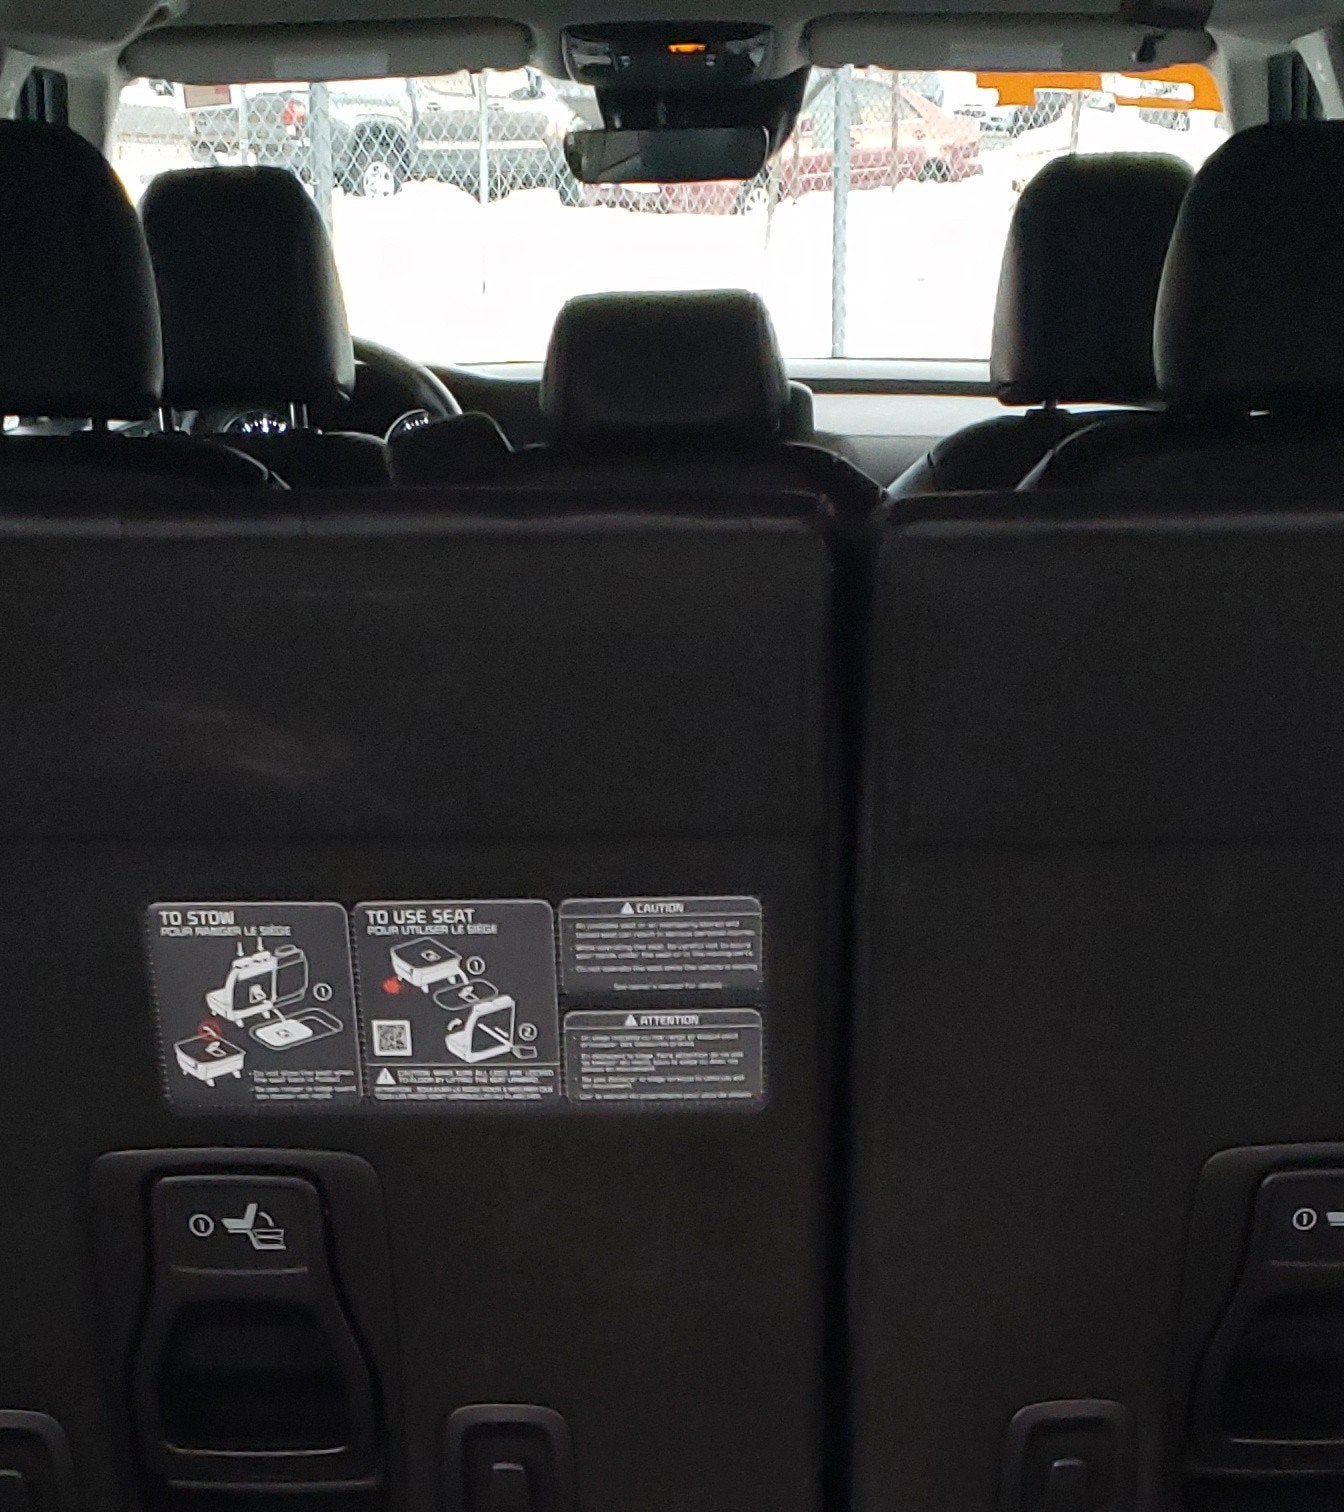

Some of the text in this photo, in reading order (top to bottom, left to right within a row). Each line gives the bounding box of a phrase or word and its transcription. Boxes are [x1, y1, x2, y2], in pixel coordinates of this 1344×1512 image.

[636, 902, 684, 914] CAUTION
[158, 911, 235, 925] TO STOW
[365, 908, 475, 925] TO USE SEAT
[160, 926, 193, 936] POUR
[243, 926, 257, 936] LE
[367, 925, 398, 935] POUR
[451, 924, 465, 935] LE
[640, 1014, 699, 1026] ATTENTION
